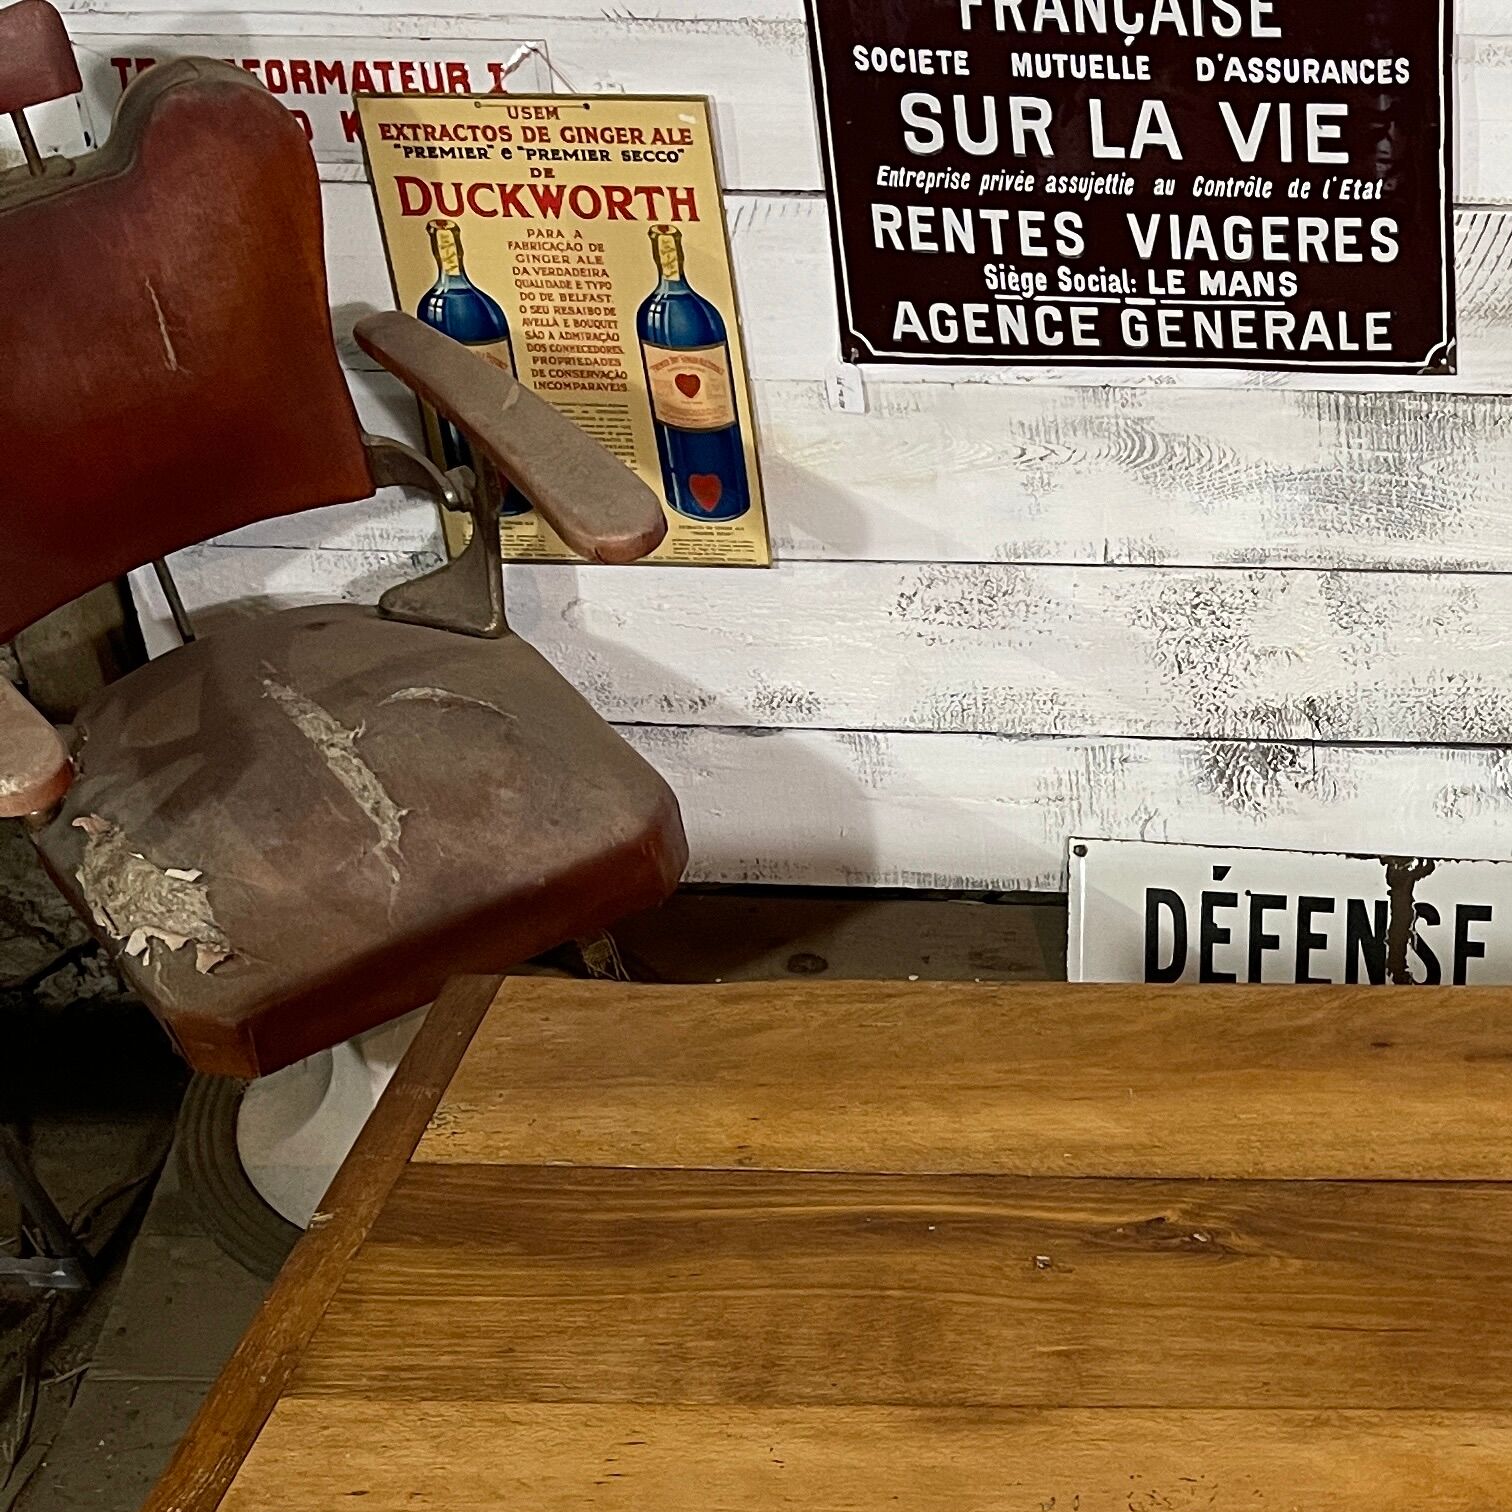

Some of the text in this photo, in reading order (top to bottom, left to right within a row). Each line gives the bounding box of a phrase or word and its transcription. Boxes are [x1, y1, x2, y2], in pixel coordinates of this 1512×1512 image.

[852, 44, 1410, 85] SOCIETE MUTUELLE D'ASSURANCES
[507, 105, 560, 120] USEM
[900, 92, 1349, 163] SUR LA VIE
[378, 123, 694, 145] EXTRACTOS DE GINGER ALE
[393, 143, 685, 163] "PREMIER" e "PREMIER SECCO"
[530, 168, 555, 179] DE
[876, 165, 1384, 201] Entreprise privée assujettie au Contrôle de l'Etat
[394, 176, 700, 222] DUCKWORTH
[527, 229, 583, 239] PARA A
[871, 203, 1399, 264] RENTES VIAGERES
[589, 243, 605, 252] DE
[516, 254, 605, 265] GINGER ALE
[512, 266, 610, 278] DA VERDADEIRA
[515, 279, 612, 290] QUALIDADE E TYPO
[983, 263, 1298, 298] Siège Social: LE MANS
[520, 292, 536, 301] DO
[540, 292, 554, 302] DE
[520, 305, 528, 314] O
[530, 305, 549, 314] SEU
[604, 307, 617, 316] DE
[563, 319, 570, 328] E
[893, 301, 1392, 351] AGENCE GENERALE
[549, 331, 556, 340] A
[526, 343, 546, 353] DOS
[531, 368, 546, 378] DE
